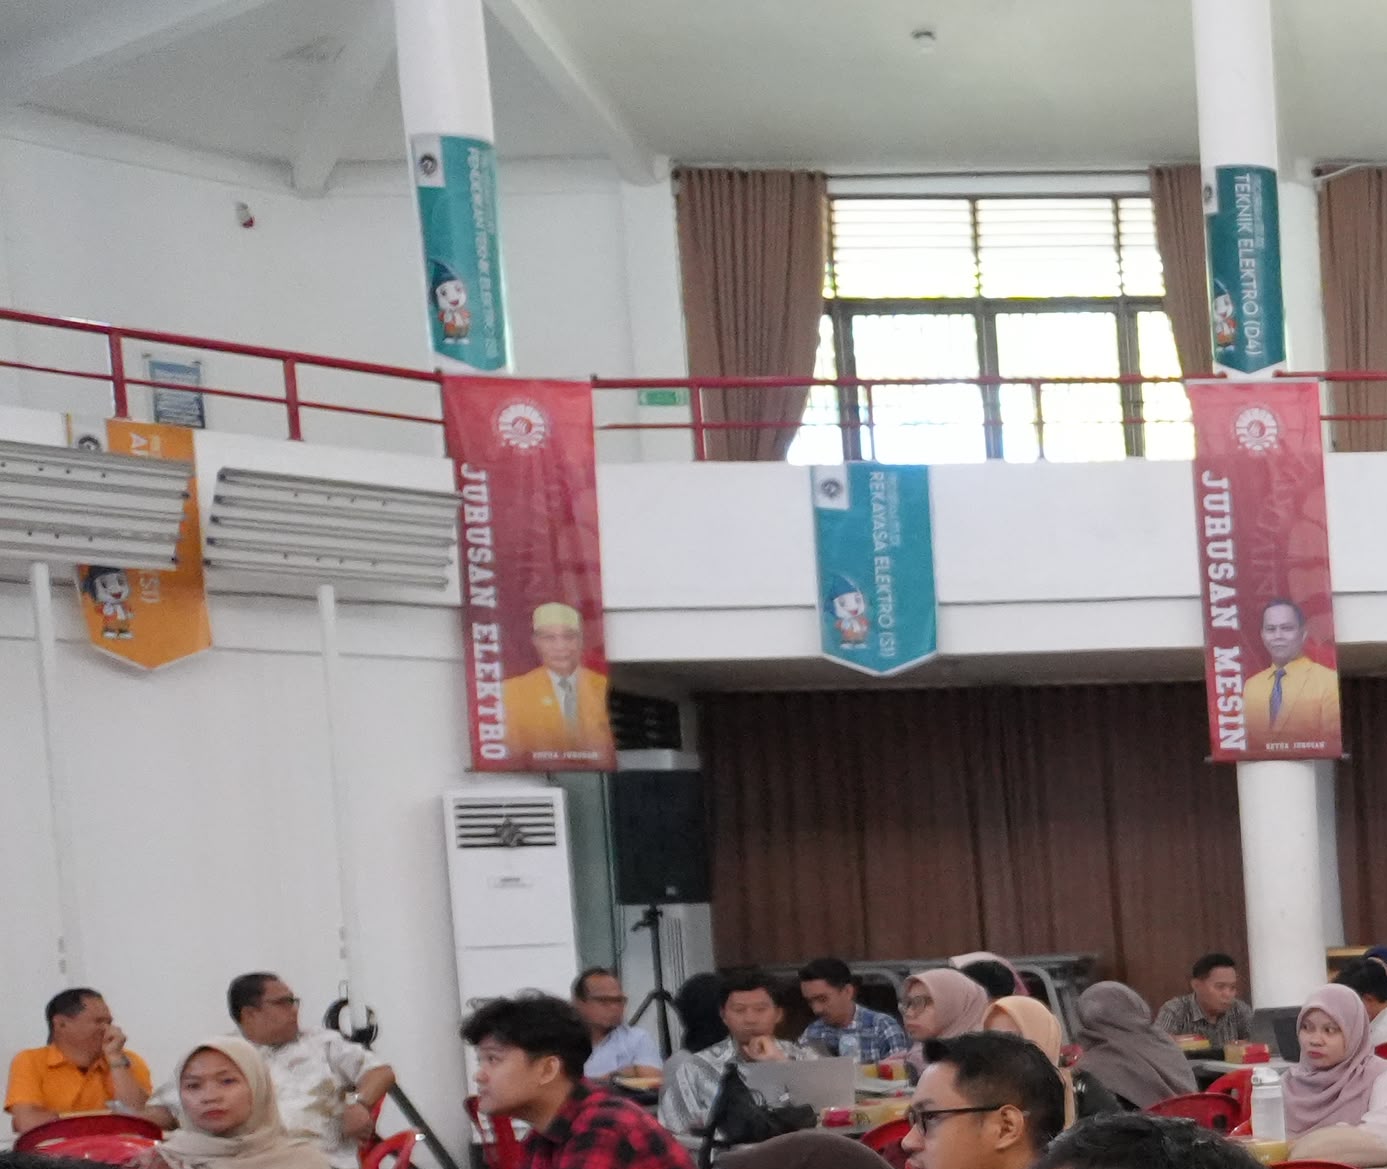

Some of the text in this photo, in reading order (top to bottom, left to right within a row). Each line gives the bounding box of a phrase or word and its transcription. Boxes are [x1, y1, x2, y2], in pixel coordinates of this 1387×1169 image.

[1234, 172, 1253, 232] TEKNIK
[1238, 238, 1259, 316] ELEKTRO
[1243, 320, 1263, 356] (D4)
[869, 471, 888, 551] REKAYASA
[460, 463, 508, 761] JURUSAN ELEKTRO
[873, 555, 894, 629] ELEKTRO
[1201, 470, 1247, 752] JURUSAN MESIN
